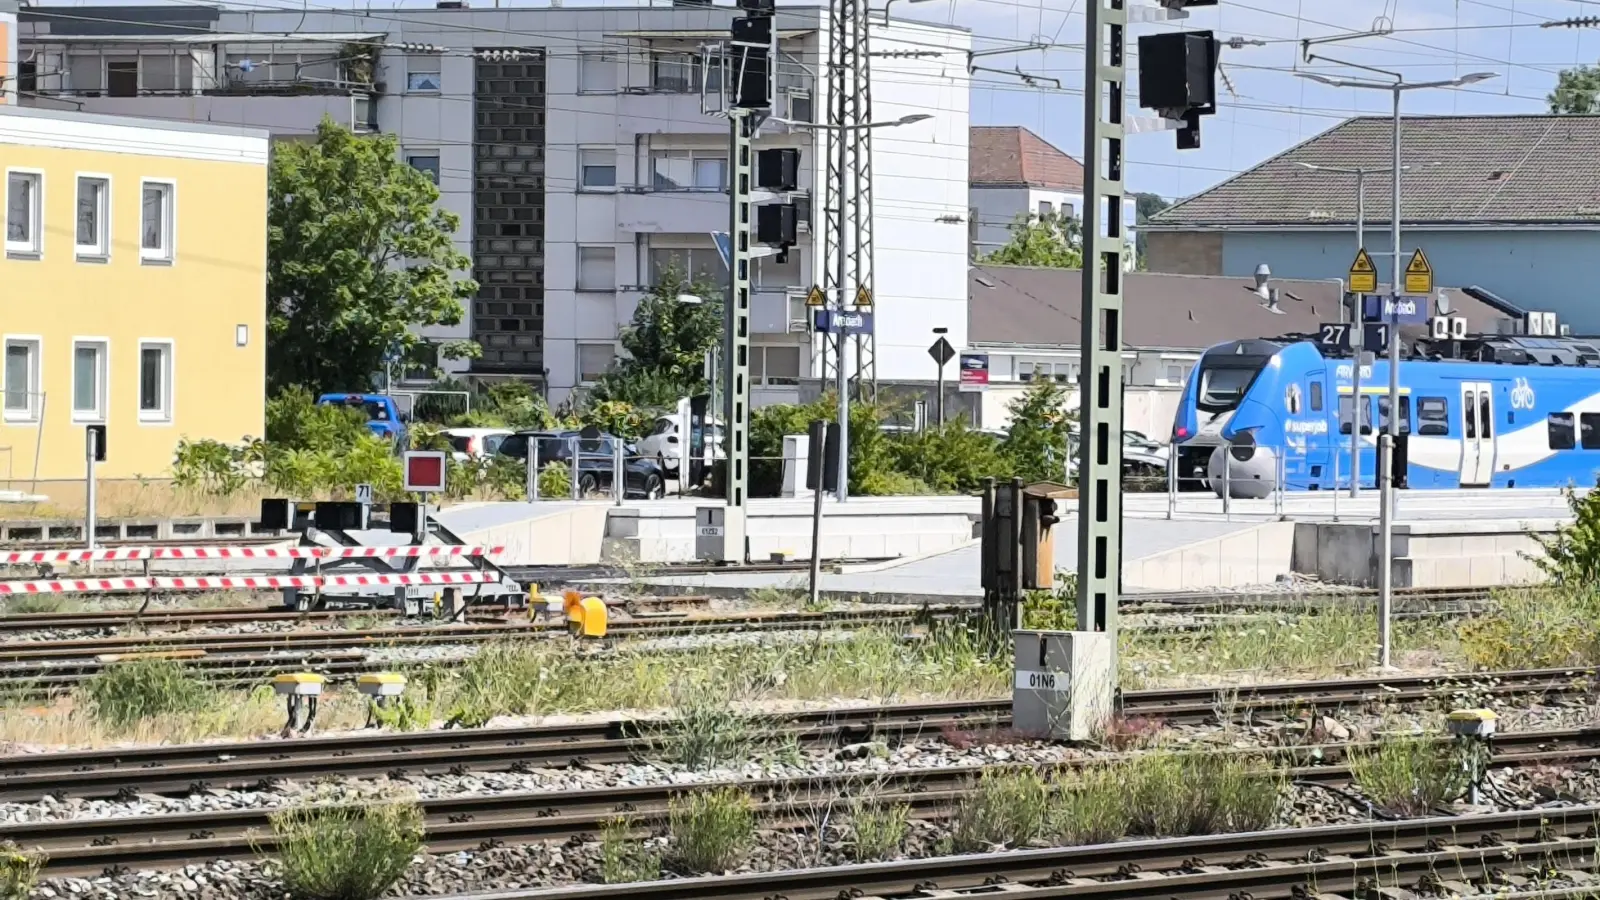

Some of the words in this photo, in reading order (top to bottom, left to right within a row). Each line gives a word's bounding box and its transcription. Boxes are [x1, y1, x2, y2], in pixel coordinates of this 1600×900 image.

[1322, 326, 1345, 344] 27
[1377, 326, 1386, 345] 1
[358, 485, 370, 498] 71
[1029, 673, 1055, 689] 01N6
